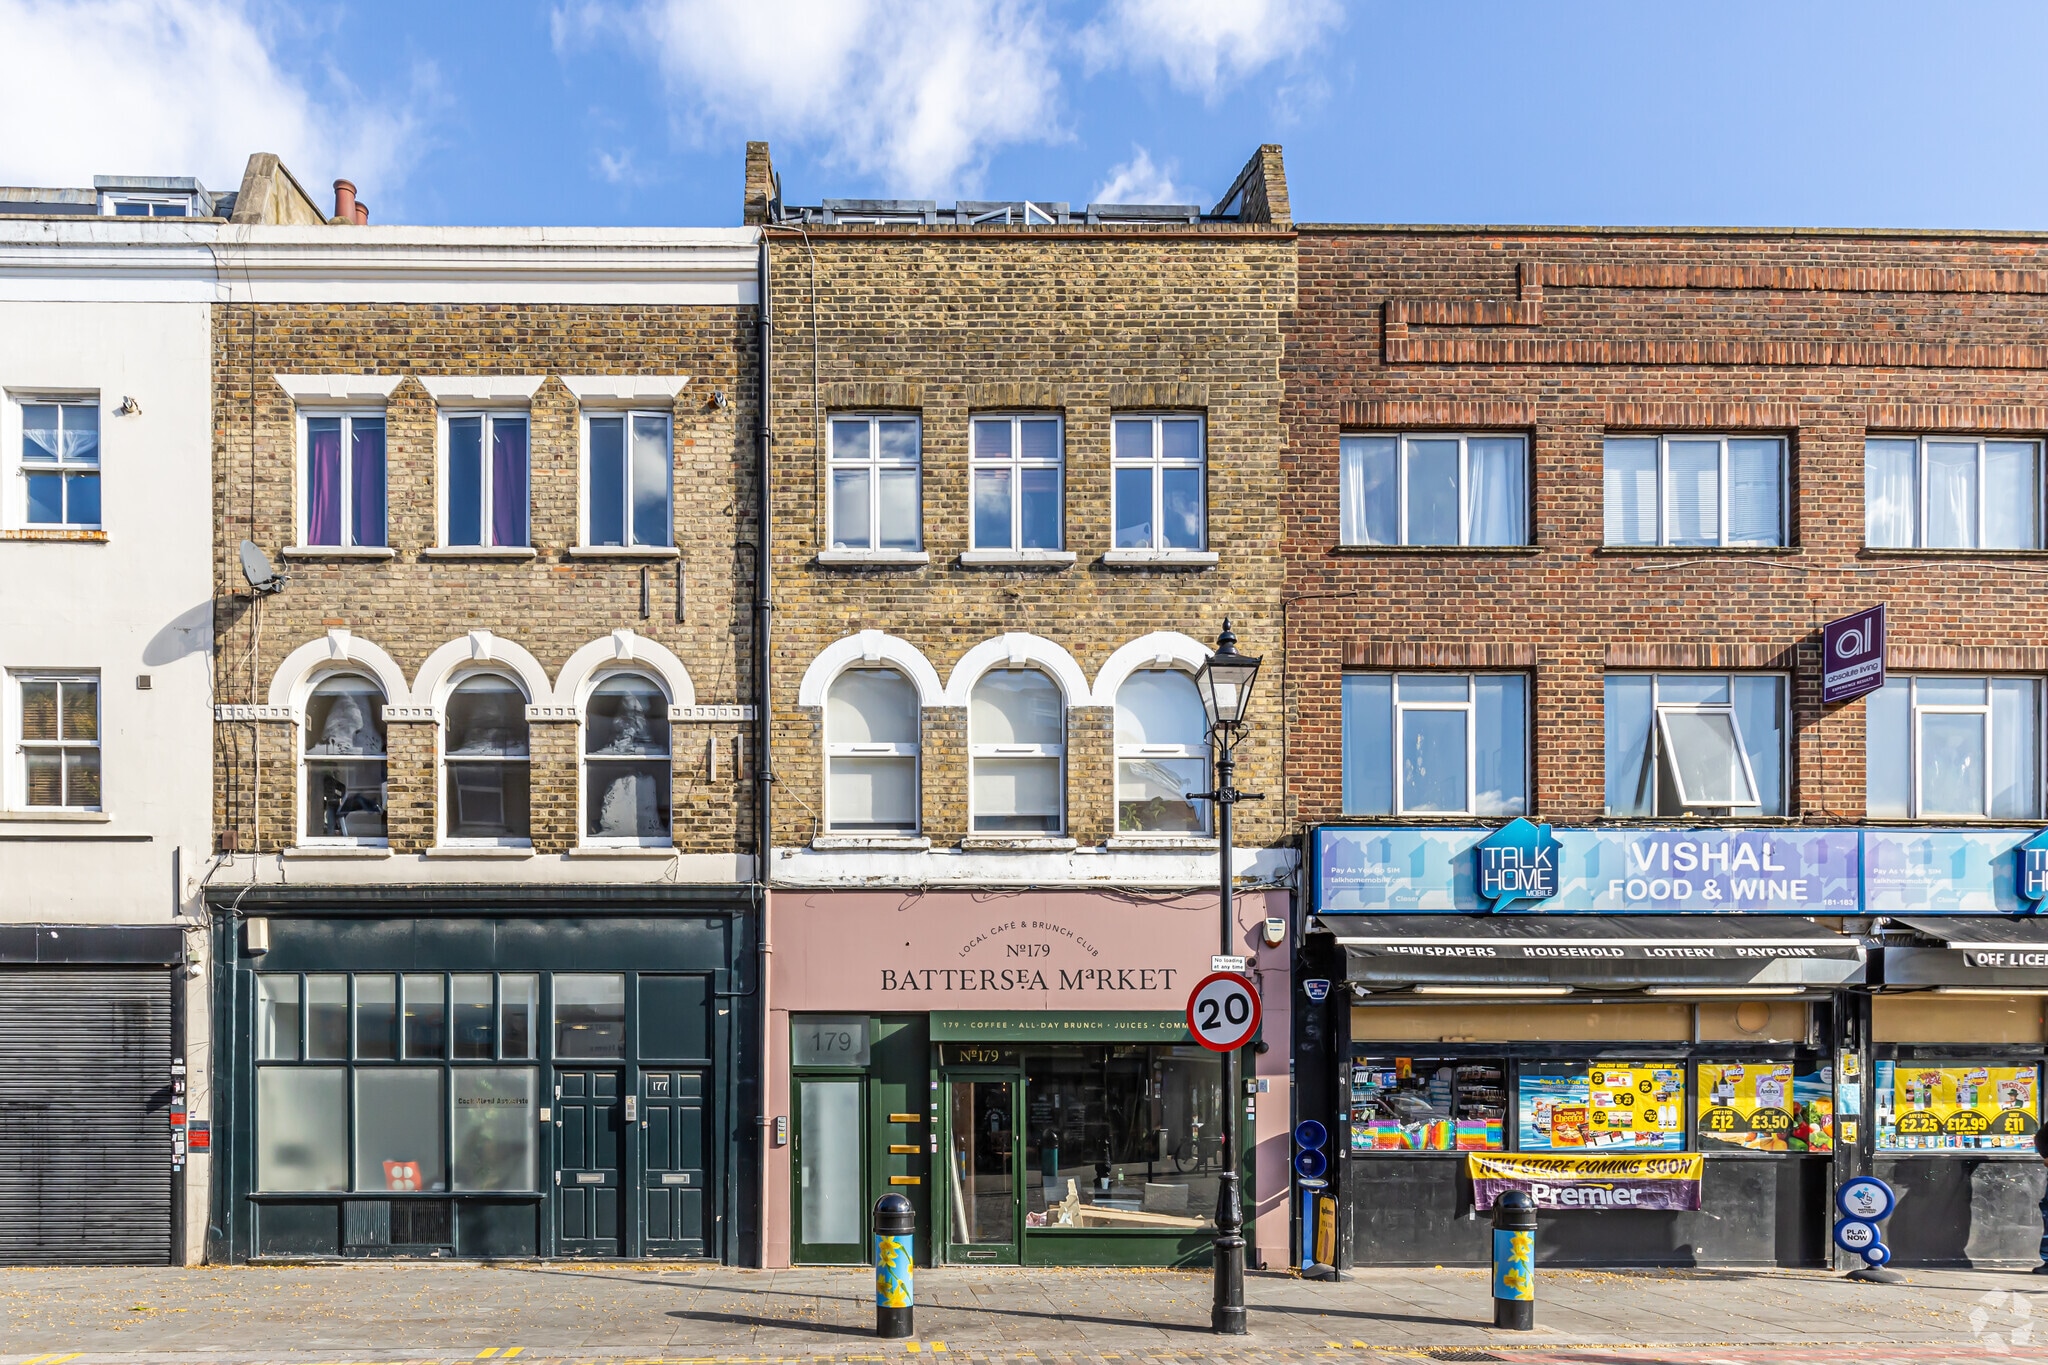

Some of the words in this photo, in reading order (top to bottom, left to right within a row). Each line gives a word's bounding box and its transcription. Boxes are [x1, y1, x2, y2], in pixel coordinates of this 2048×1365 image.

[1836, 617, 1871, 659] al
[1828, 669, 1859, 683] absolute
[1860, 662, 1879, 673] living
[1831, 682, 1856, 693] EXPERIENCE
[1857, 676, 1874, 685] RESULTS
[1485, 846, 1553, 869] TALK
[1631, 842, 1785, 872] VISHAL
[1331, 867, 1345, 875] Pay
[1873, 868, 1887, 876] Pay
[1484, 868, 1553, 892] HOME
[1608, 879, 1693, 900] FOOD
[1702, 879, 1723, 900] &
[1730, 879, 1808, 900] WINE
[959, 933, 988, 958] LOCAL
[990, 921, 1016, 935] CAFÉ
[1020, 920, 1027, 928] &
[1032, 921, 1075, 938] BRUNCH
[1076, 936, 1099, 958] CLUB
[1523, 947, 1625, 957] HOUSEHOLD
[1644, 947, 1716, 957] LOTTERY
[1737, 947, 1817, 957] PAYPOINT
[1977, 952, 2005, 965] OFF
[880, 969, 1050, 991] BATTERSEA
[1198, 993, 1250, 1031] 20
[812, 1032, 852, 1051] 179
[653, 1081, 668, 1091] 177
[1554, 1113, 1585, 1123] Cheerios
[1711, 1115, 1734, 1129] £12
[1751, 1115, 1789, 1129] £3.50
[1900, 1118, 1938, 1133] £2.25
[1947, 1117, 1987, 1131] £12.99
[2004, 1118, 2024, 1131] £11
[1480, 1158, 1516, 1174] NEW
[1521, 1158, 1575, 1174] STORE
[1575, 1160, 1642, 1174] COMING
[1646, 1158, 1693, 1174] SOON
[1531, 1183, 1642, 1206] Premier
